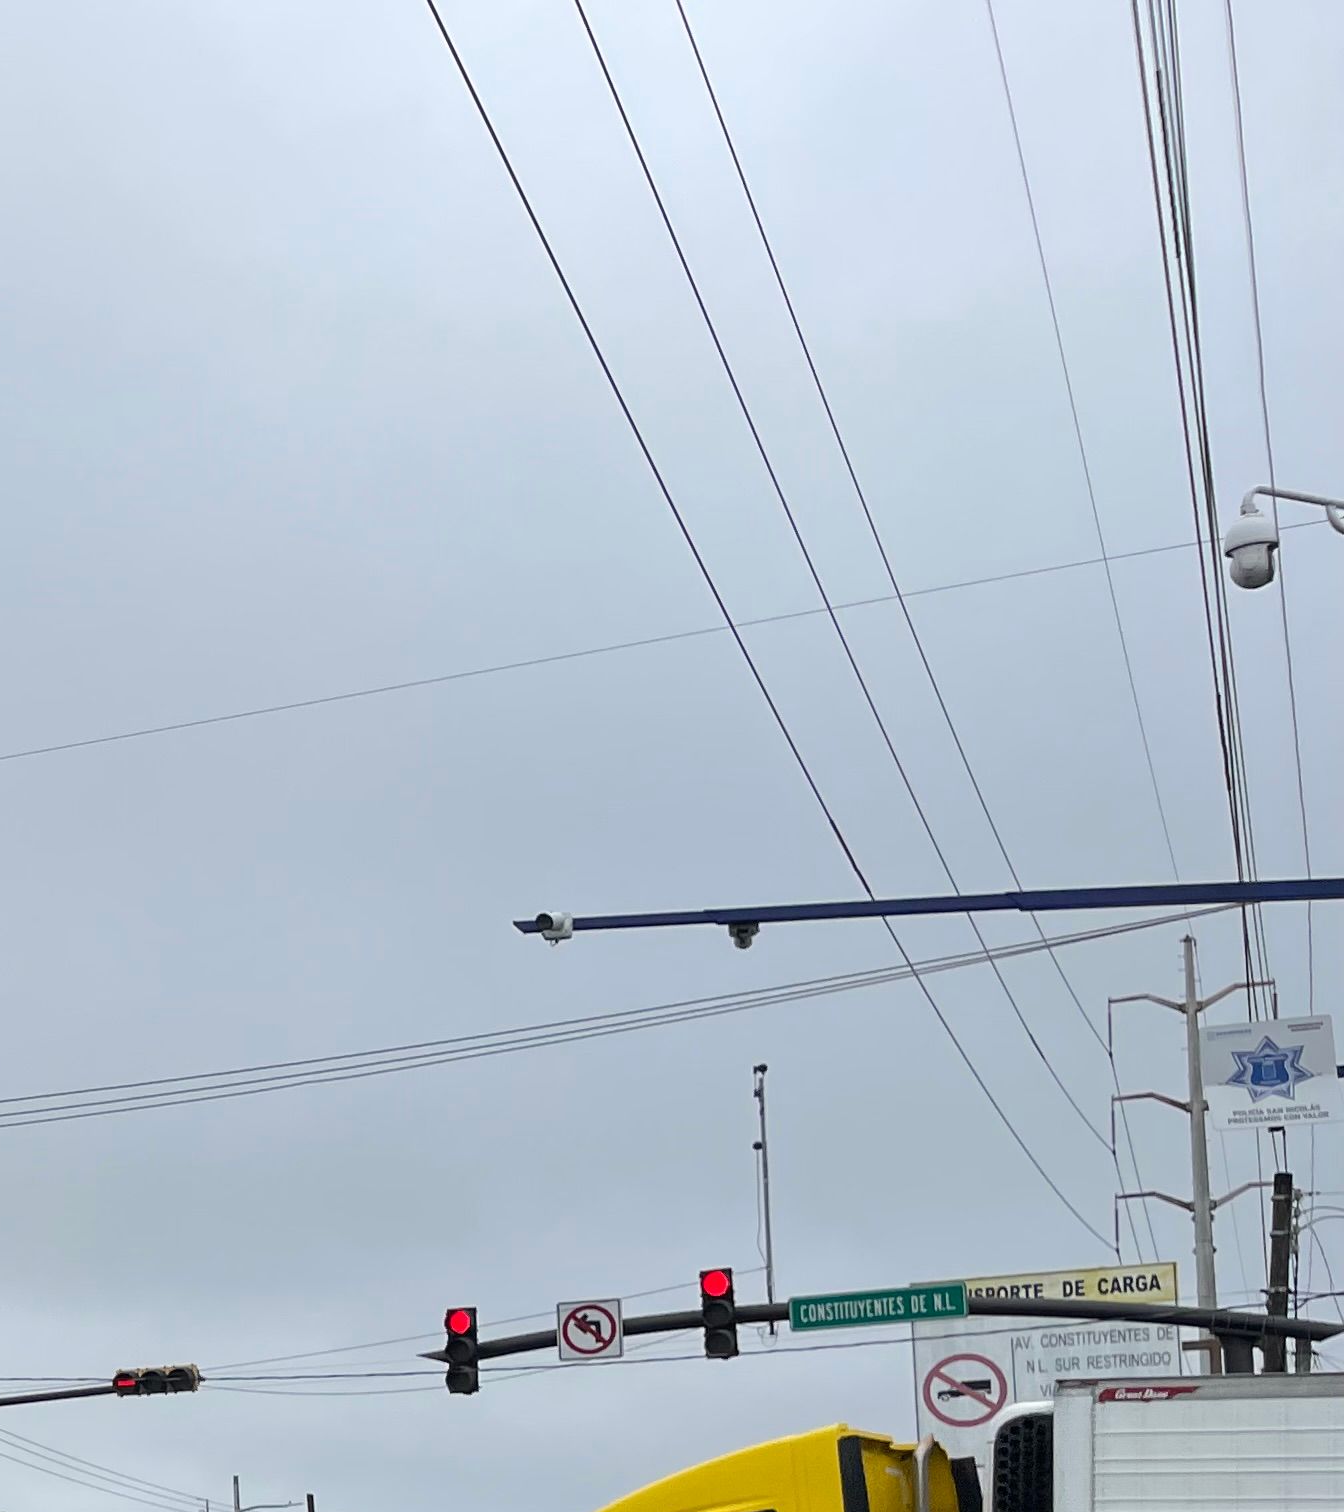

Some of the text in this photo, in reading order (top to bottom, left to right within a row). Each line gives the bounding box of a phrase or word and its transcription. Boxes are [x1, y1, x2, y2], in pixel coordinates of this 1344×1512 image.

[968, 1274, 1162, 1299] SPORTE DE CARGA
[799, 1292, 956, 1323] CONSTITUYENTES DE N.L.
[1040, 1327, 1150, 1349] CONSTITUYENTES
[1157, 1325, 1175, 1341] DE
[1055, 1357, 1081, 1372] SUR
[1086, 1351, 1172, 1370] RESTRINGIDO
